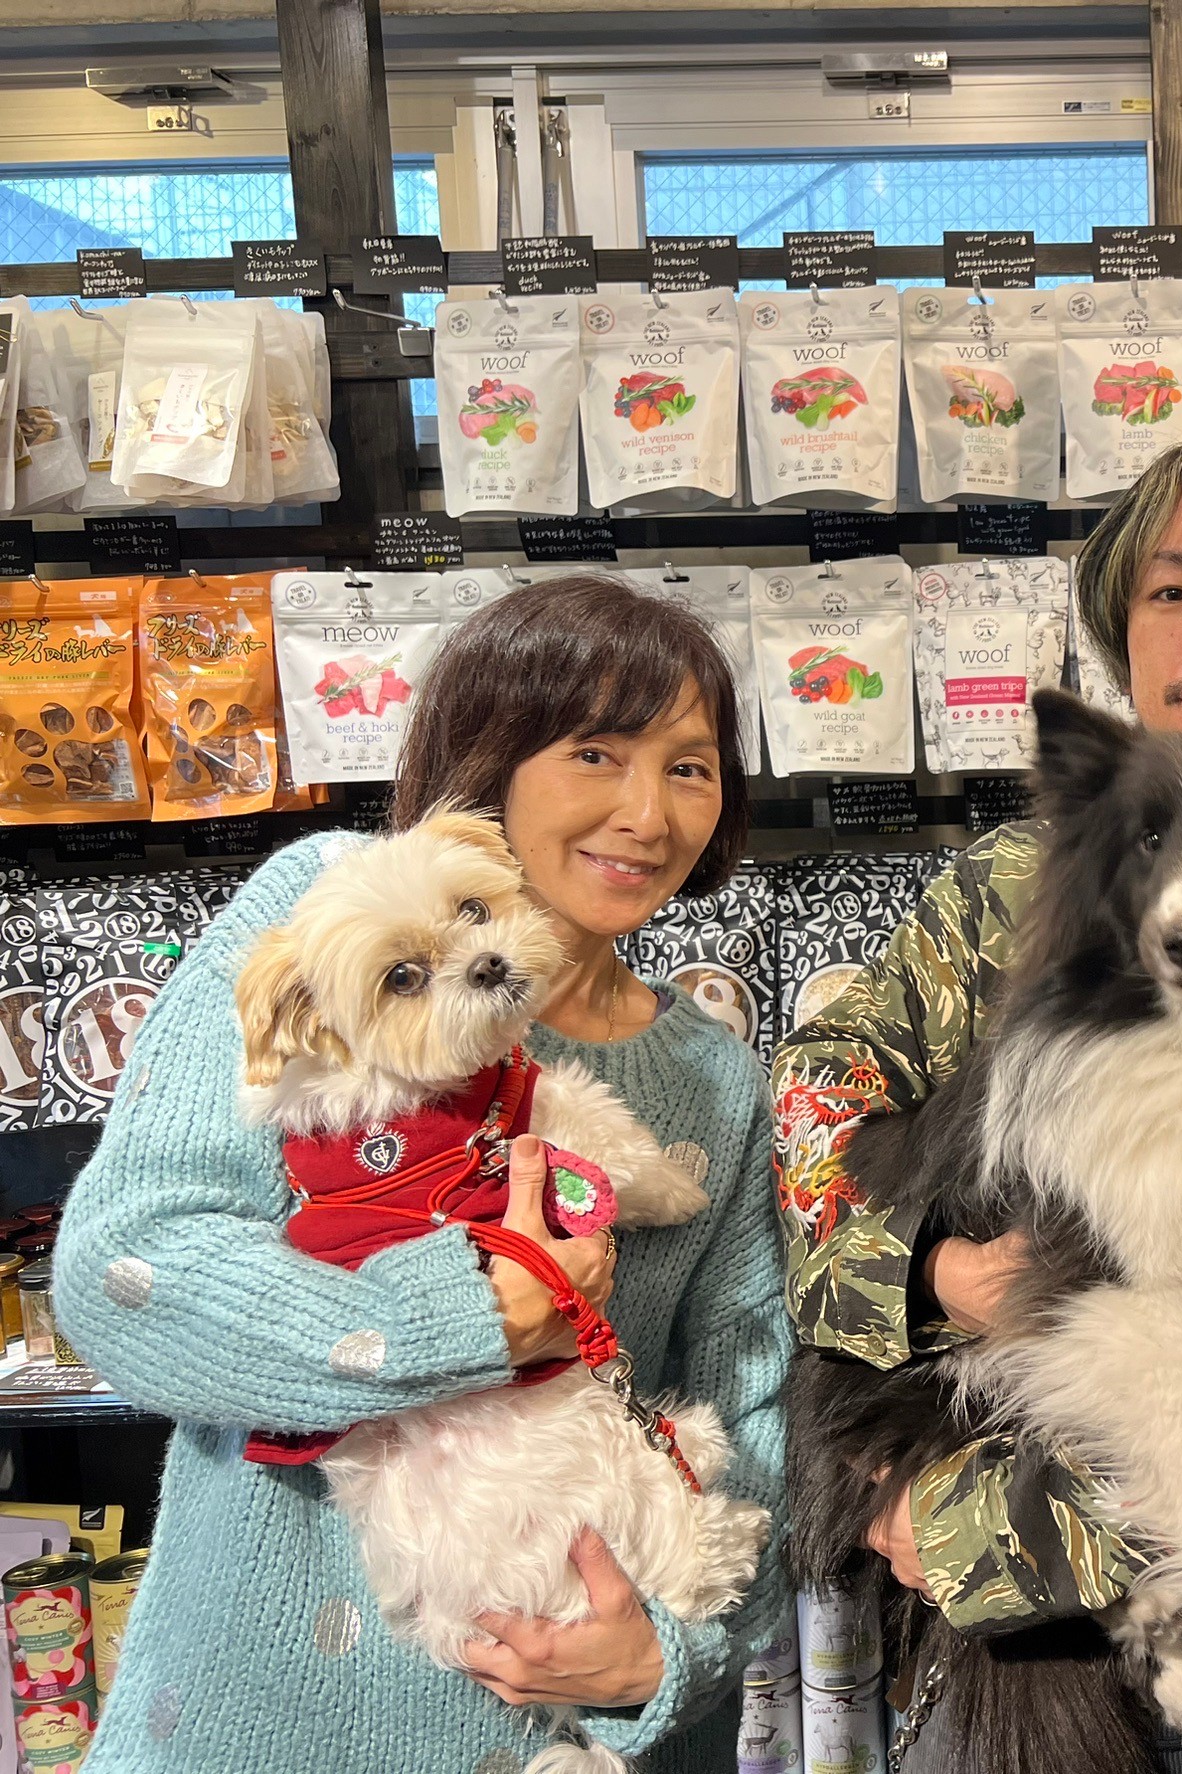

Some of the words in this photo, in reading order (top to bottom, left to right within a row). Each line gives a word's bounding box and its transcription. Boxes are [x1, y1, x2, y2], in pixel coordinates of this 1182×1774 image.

[793, 342, 848, 361] woof
[956, 341, 1009, 359] woof
[1111, 337, 1163, 356] woof
[480, 350, 530, 371] woof
[630, 346, 686, 366] woof
[621, 437, 646, 449] wild
[649, 431, 695, 445] venison
[780, 435, 805, 447] wild
[808, 431, 858, 444] brushtail
[964, 432, 1007, 446] chicken
[1122, 429, 1153, 440] lamb
[638, 443, 677, 457] recipe
[799, 442, 837, 455] recipe
[968, 443, 1004, 457] recipe
[1118, 440, 1156, 453] recipe
[478, 459, 511, 472] recipe
[381, 517, 428, 528] meow
[0, 616, 50, 642] リーズ
[322, 626, 400, 643] meow
[809, 618, 863, 637] woof
[959, 644, 1012, 664] woof
[948, 682, 968, 693] lamb
[972, 683, 999, 695] green
[1000, 681, 1024, 694] tripe
[813, 710, 839, 721] wild
[840, 712, 866, 724] goat
[326, 722, 356, 734] beef
[358, 722, 367, 733] &
[371, 721, 399, 733] hoki
[821, 723, 859, 735] recipe
[343, 733, 383, 746] recipe
[721, 936, 750, 959] 18
[98, 1595, 128, 1613] Terra
[42, 1610, 75, 1622] Canis
[759, 1699, 789, 1711] Canis
[836, 1703, 868, 1715] Canis
